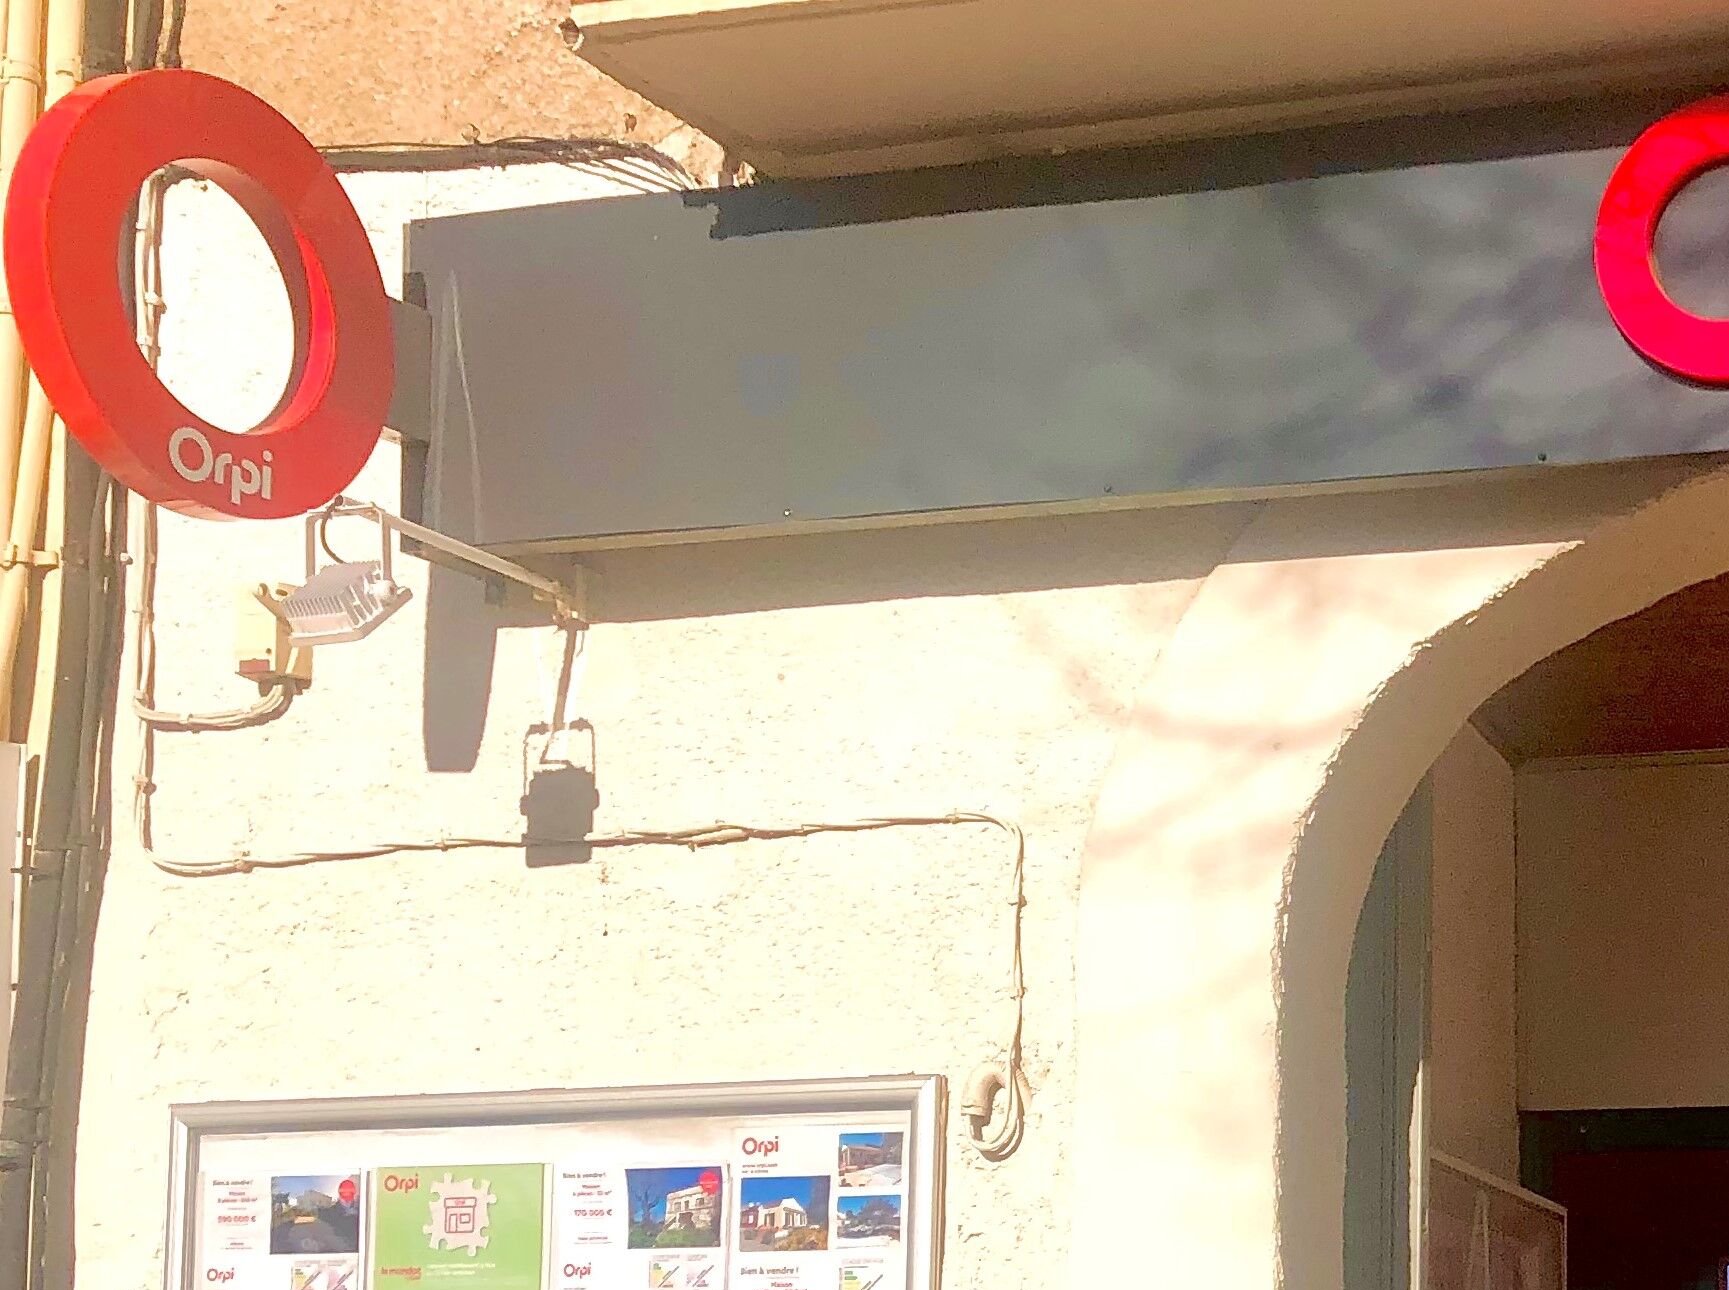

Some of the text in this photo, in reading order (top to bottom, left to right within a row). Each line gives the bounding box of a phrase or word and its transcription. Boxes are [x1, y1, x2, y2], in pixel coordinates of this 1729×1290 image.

[168, 427, 274, 503] Orpi
[741, 1135, 779, 1157] Orpi
[383, 1173, 419, 1193] Orpi
[206, 1267, 235, 1284] Orpi
[564, 1261, 592, 1279] Orpi
